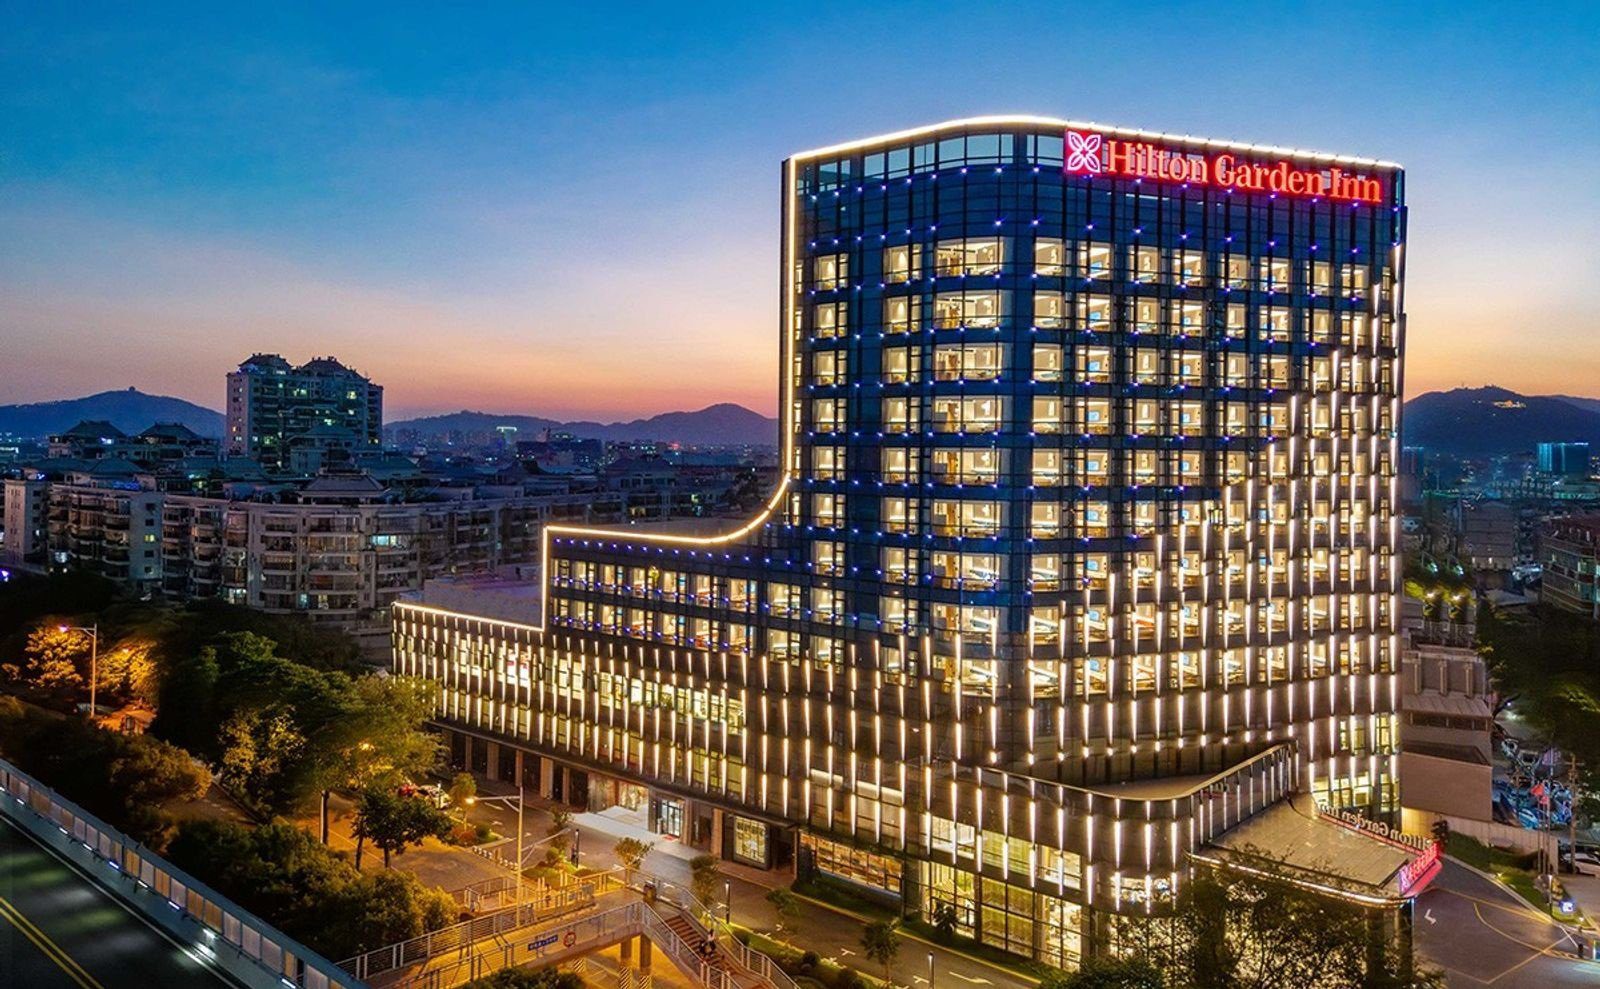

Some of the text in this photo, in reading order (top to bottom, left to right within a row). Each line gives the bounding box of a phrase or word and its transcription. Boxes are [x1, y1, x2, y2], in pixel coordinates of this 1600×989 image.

[1107, 140, 1382, 203] Hilton Garden Inn
